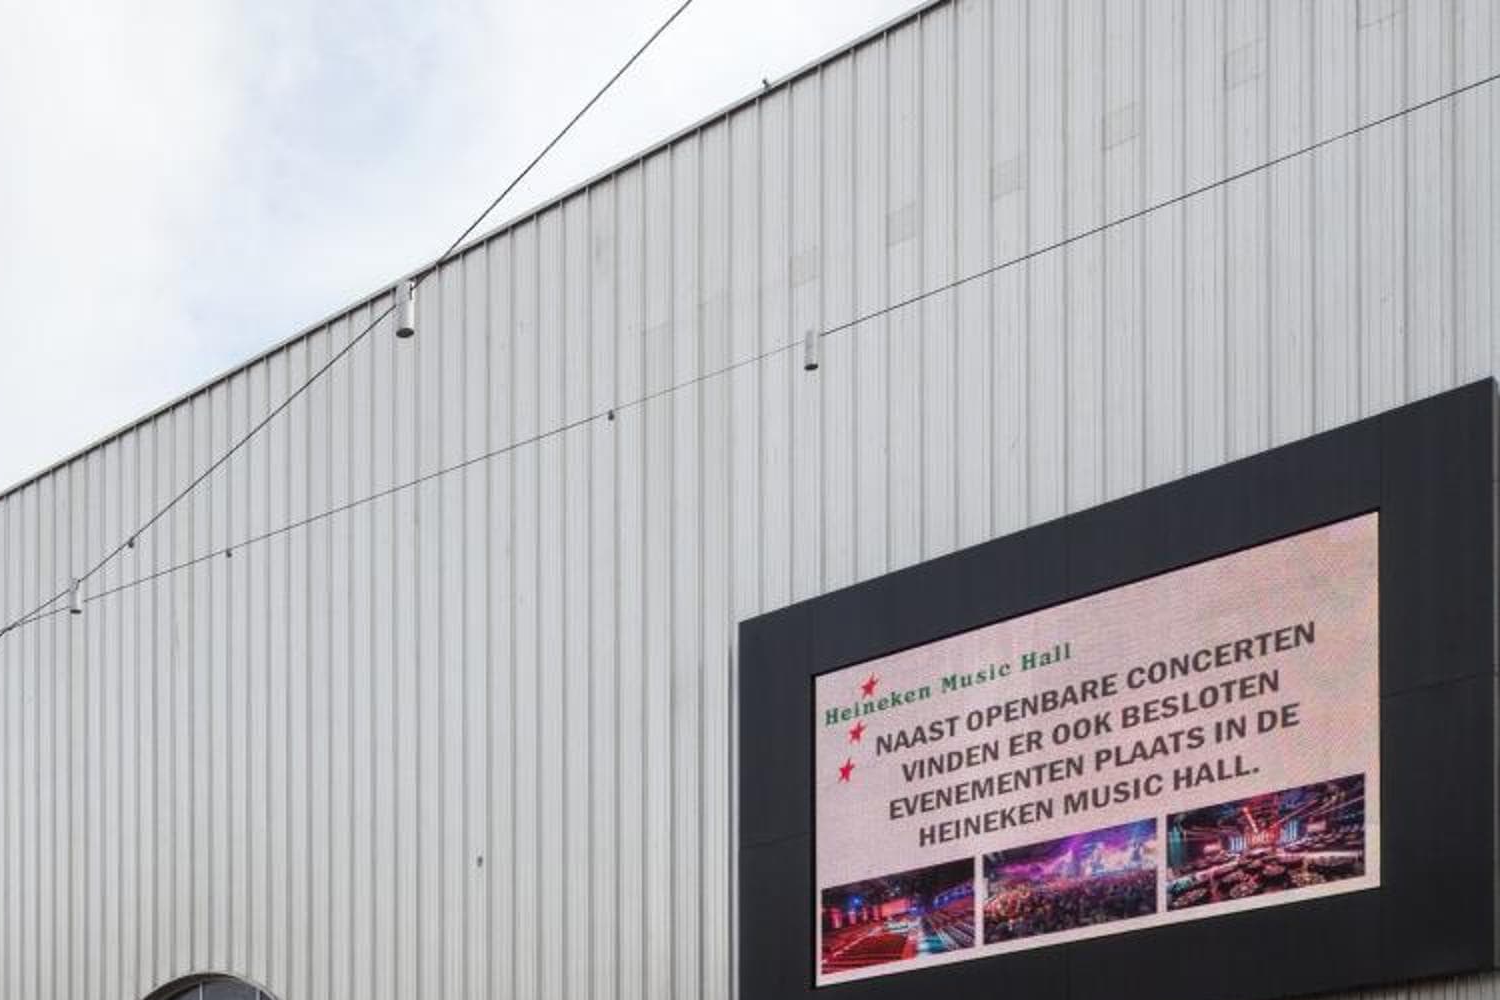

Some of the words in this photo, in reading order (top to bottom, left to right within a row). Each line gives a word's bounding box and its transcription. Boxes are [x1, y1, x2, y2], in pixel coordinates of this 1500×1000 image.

[825, 684, 931, 726] Heineken
[940, 663, 1011, 694] Music
[1020, 642, 1071, 672] Hall
[875, 715, 961, 757] NAAST
[966, 673, 1118, 732] OPENBARE
[1126, 620, 1315, 690] CONCERTEN
[901, 740, 1000, 783] VINDEN
[1008, 730, 1044, 757] ER
[1051, 711, 1113, 746] OOK
[1121, 669, 1279, 730] BESLOTEN
[888, 755, 1084, 821] EVENEMENTEN
[1094, 726, 1205, 772] PLAATS
[1214, 715, 1247, 745] IN
[1256, 702, 1301, 735] DE
[918, 797, 1054, 848] HEINEKEN
[1063, 773, 1164, 815] MUSIC
[1172, 754, 1260, 792] HALL.
